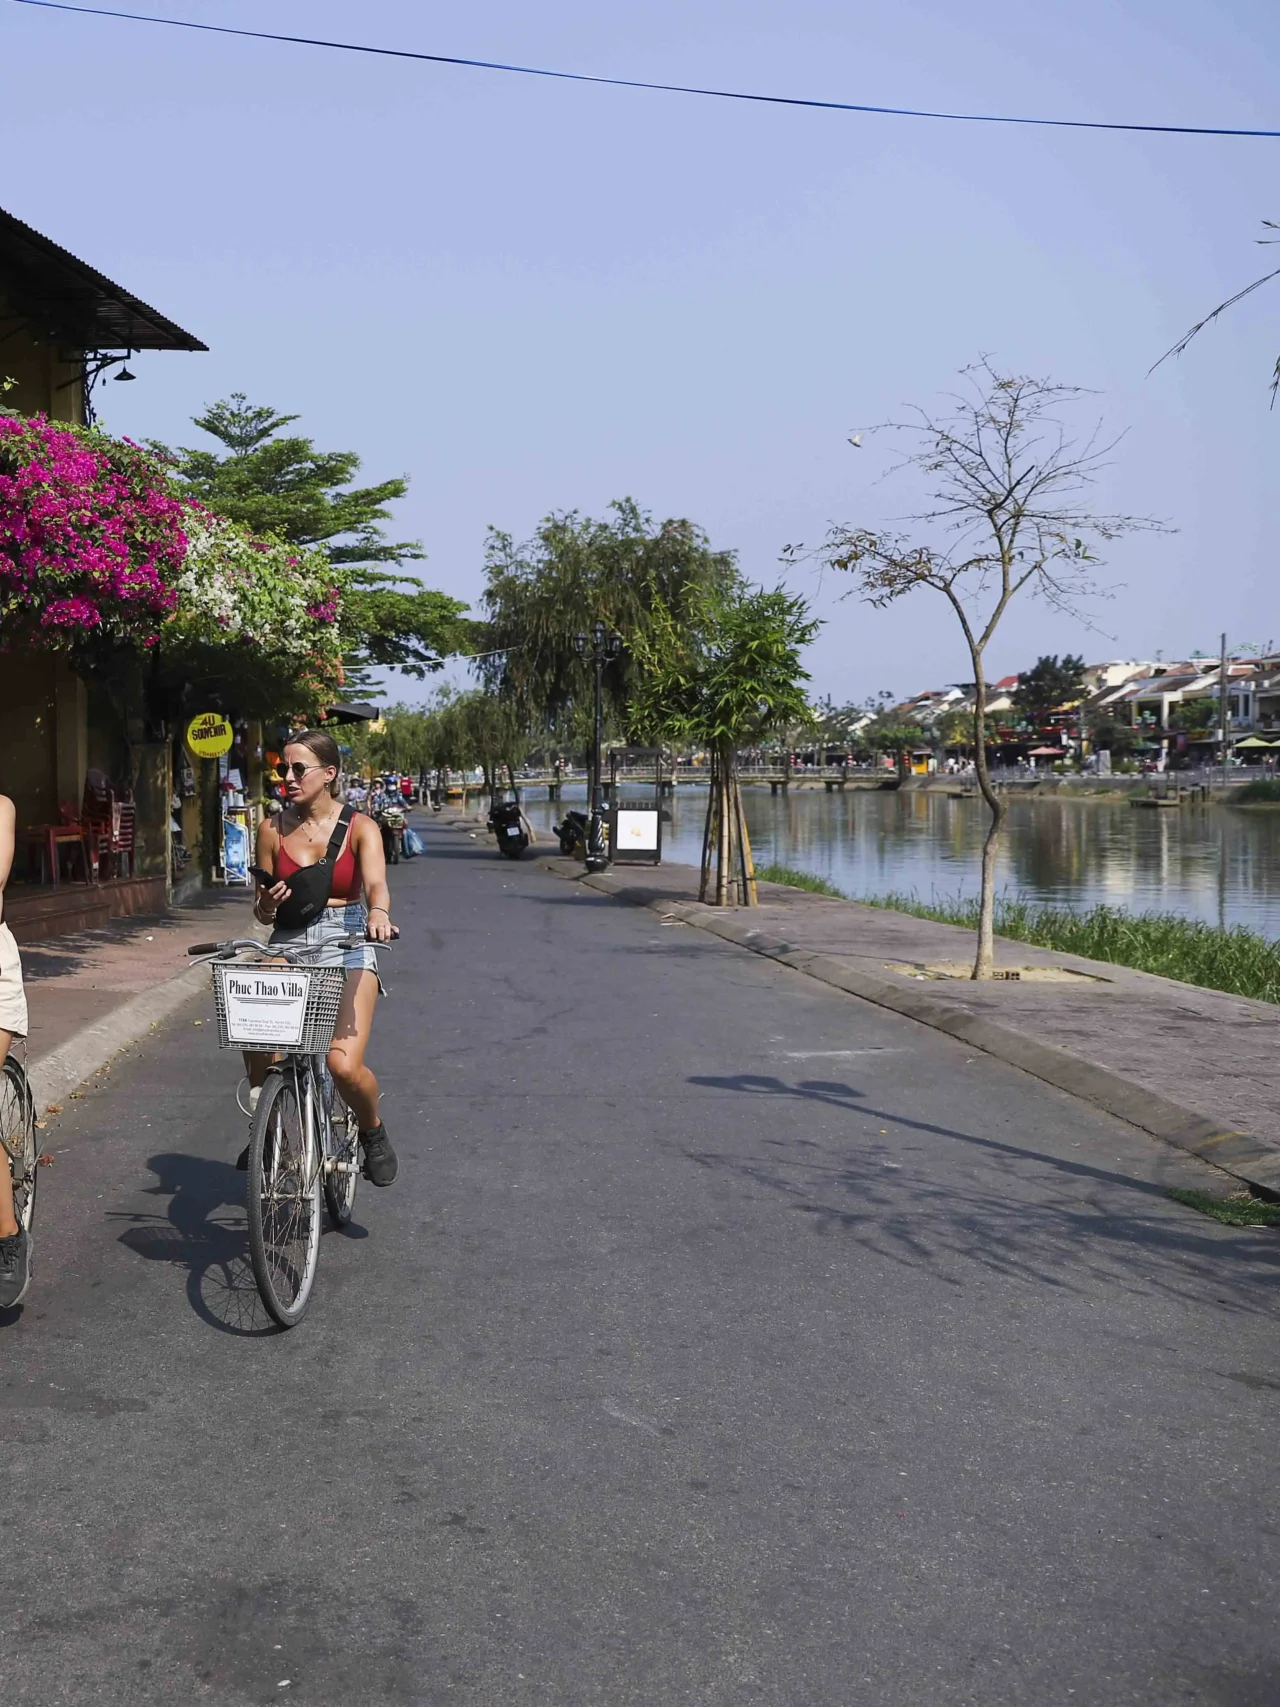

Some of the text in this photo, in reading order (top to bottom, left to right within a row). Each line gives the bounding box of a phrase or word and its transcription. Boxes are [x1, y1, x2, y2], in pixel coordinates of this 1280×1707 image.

[200, 715, 215, 726] 4U
[191, 724, 227, 741] SOUVENIR
[229, 979, 303, 997] Phuc Thao Villa
